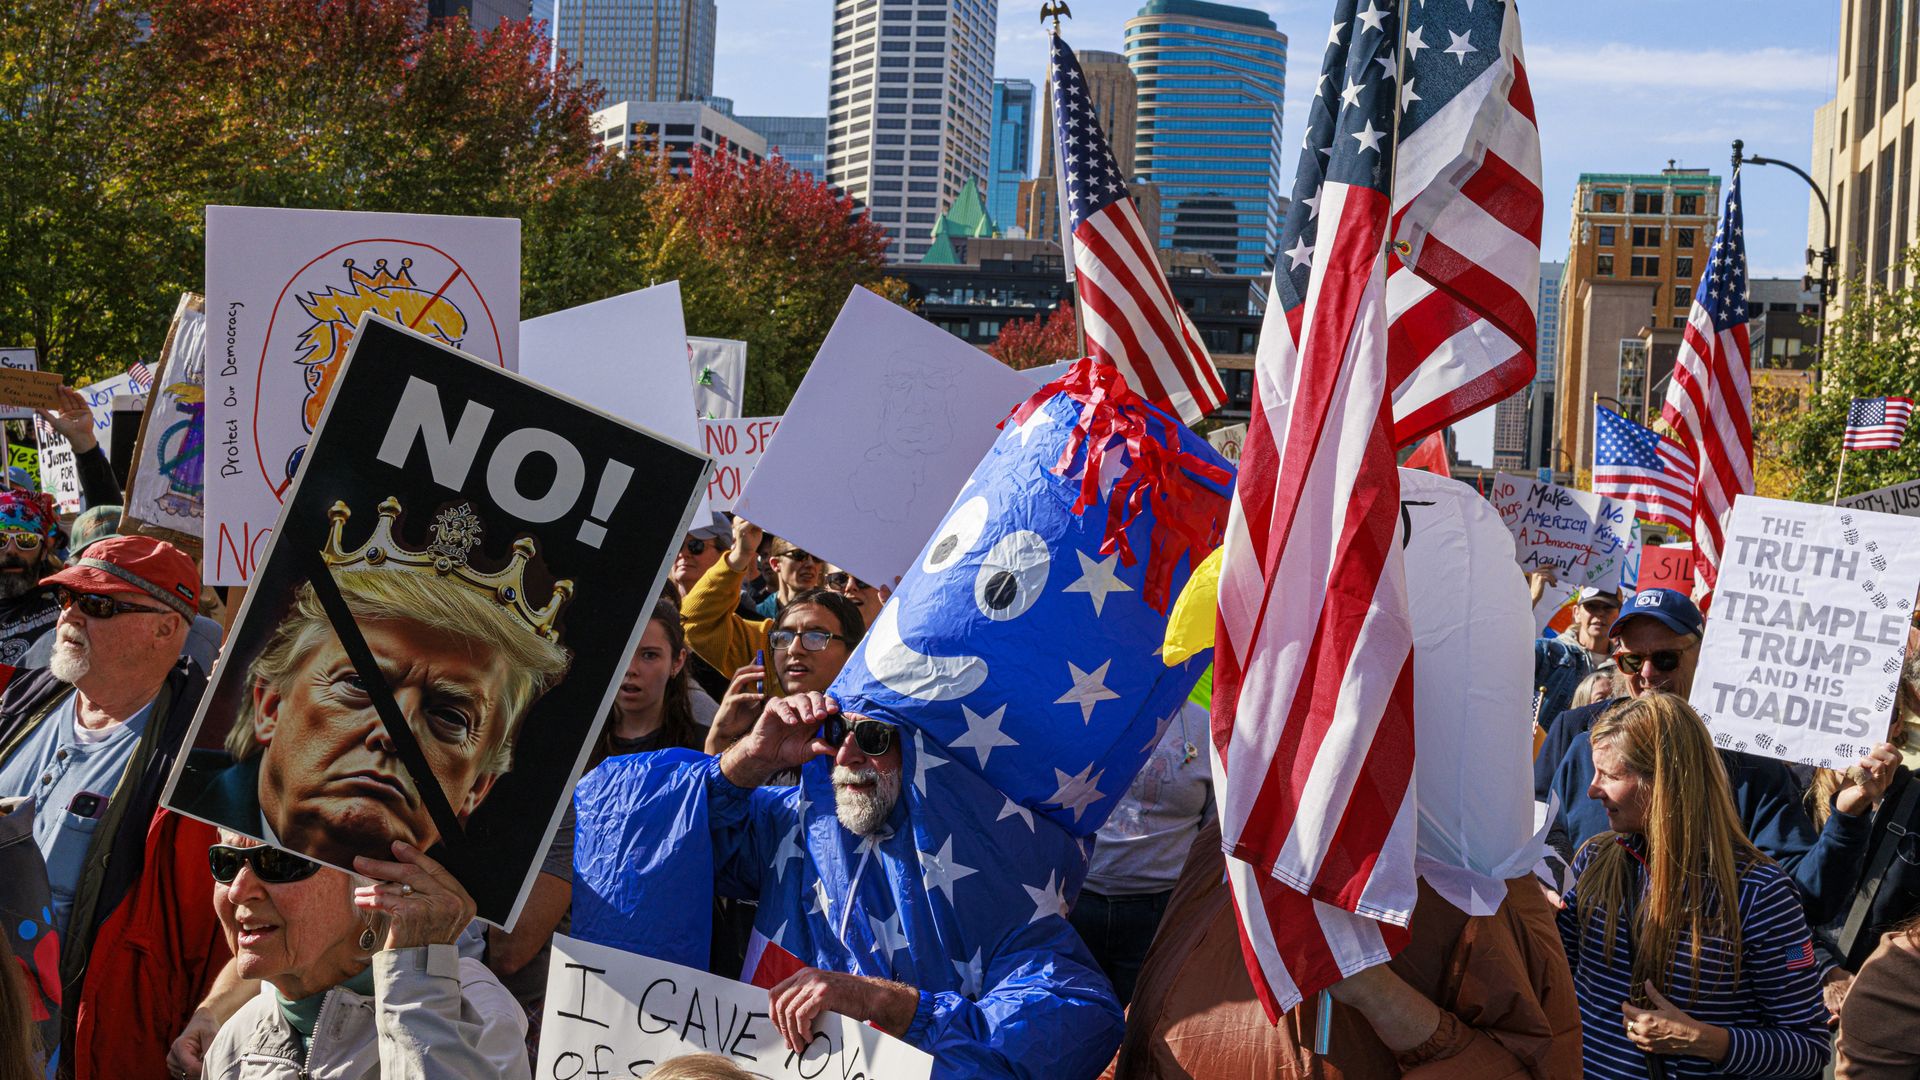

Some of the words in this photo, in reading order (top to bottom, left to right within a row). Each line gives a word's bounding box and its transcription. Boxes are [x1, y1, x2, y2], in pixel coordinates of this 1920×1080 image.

[220, 302, 244, 376] Democracy
[223, 385, 238, 406] Our
[220, 418, 243, 478] Protect
[705, 424, 737, 455] NO
[9, 448, 39, 465] Yes
[376, 375, 635, 549] NO!
[61, 466, 75, 479] FOR
[62, 482, 75, 492] ALL
[1494, 483, 1515, 501] NO
[1527, 483, 1573, 511] Make
[1761, 516, 1807, 538] THE
[1531, 529, 1600, 565] Democracy
[1735, 535, 1860, 581] TRUTH
[1748, 571, 1805, 596] WILL
[1722, 591, 1905, 646] TRAMPLE
[1738, 628, 1871, 675] TRUMP
[1746, 666, 1798, 689] AND
[1803, 674, 1845, 697] HIS
[1712, 681, 1872, 738] TOADIES
[557, 963, 609, 1028] I
[637, 978, 769, 1062] GAVE
